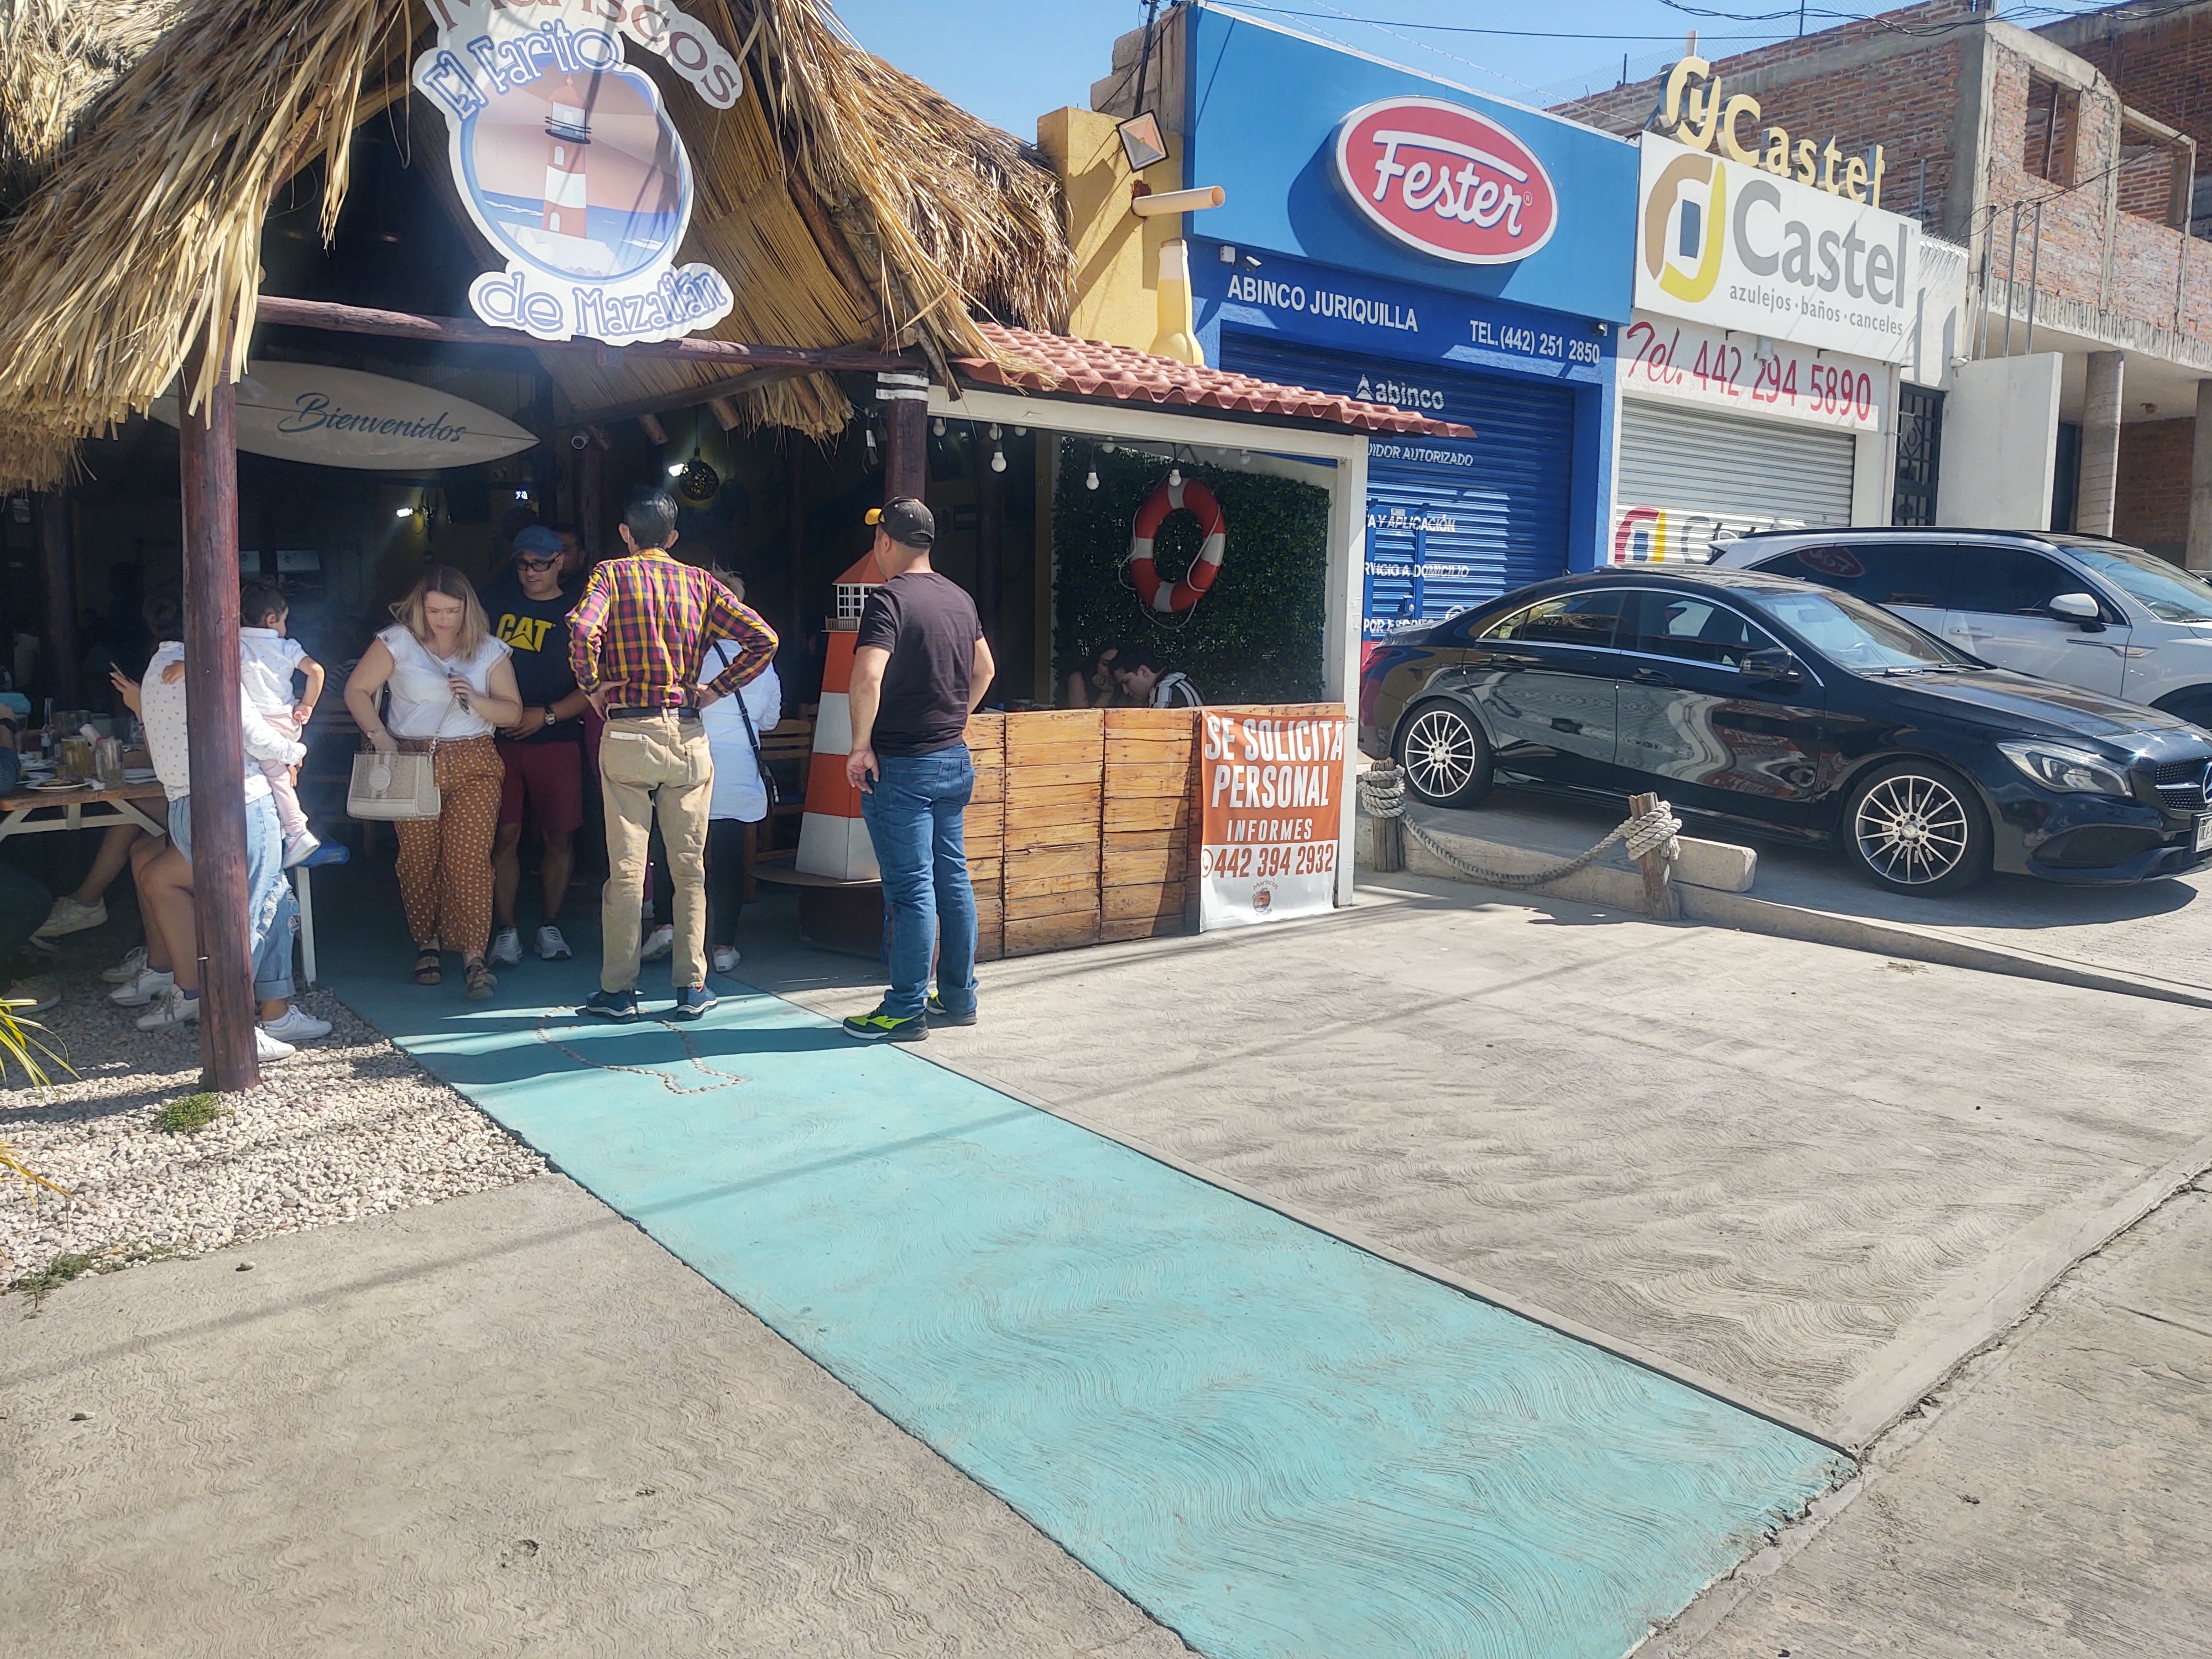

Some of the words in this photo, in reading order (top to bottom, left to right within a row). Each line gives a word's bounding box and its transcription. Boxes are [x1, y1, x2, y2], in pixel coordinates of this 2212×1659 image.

[422, 49, 490, 121] El
[466, 18, 624, 95] Farito
[1715, 94, 1886, 207] Castel
[1371, 129, 1528, 237] Fester
[1732, 180, 1907, 308] Castel
[477, 271, 565, 333] de
[571, 270, 728, 337] Mazatlán
[1227, 274, 1306, 311] ABINCO
[1310, 290, 1418, 332] JURIQUILLA
[1729, 284, 1791, 314] azulejos
[1801, 295, 1840, 323] baños
[1849, 311, 1903, 336] canceles
[1538, 333, 1563, 358] 251
[1568, 339, 1600, 364] 2850
[1626, 321, 1682, 386] Tel.
[1693, 340, 1741, 397] 442
[1752, 354, 1798, 406] 294
[1810, 363, 1871, 421] 5890
[278, 392, 466, 442] Bienvenidos
[1375, 380, 1445, 410] abinco
[1402, 446, 1474, 466] AUTORIZADO
[1367, 514, 1376, 528] A
[1386, 514, 1456, 533] APLICACIÓN
[1413, 564, 1470, 578] DOMICILIO
[496, 613, 553, 653] CAT
[1204, 715, 1235, 760] SE
[1242, 719, 1345, 761] SOLICITA
[1211, 765, 1329, 808] PERSONAL
[1226, 818, 1313, 842] INFORMES
[1214, 848, 1252, 878] 442
[1257, 847, 1291, 877] 394
[1295, 843, 1334, 875] 2932
[1253, 879, 1279, 891] Mariscos
